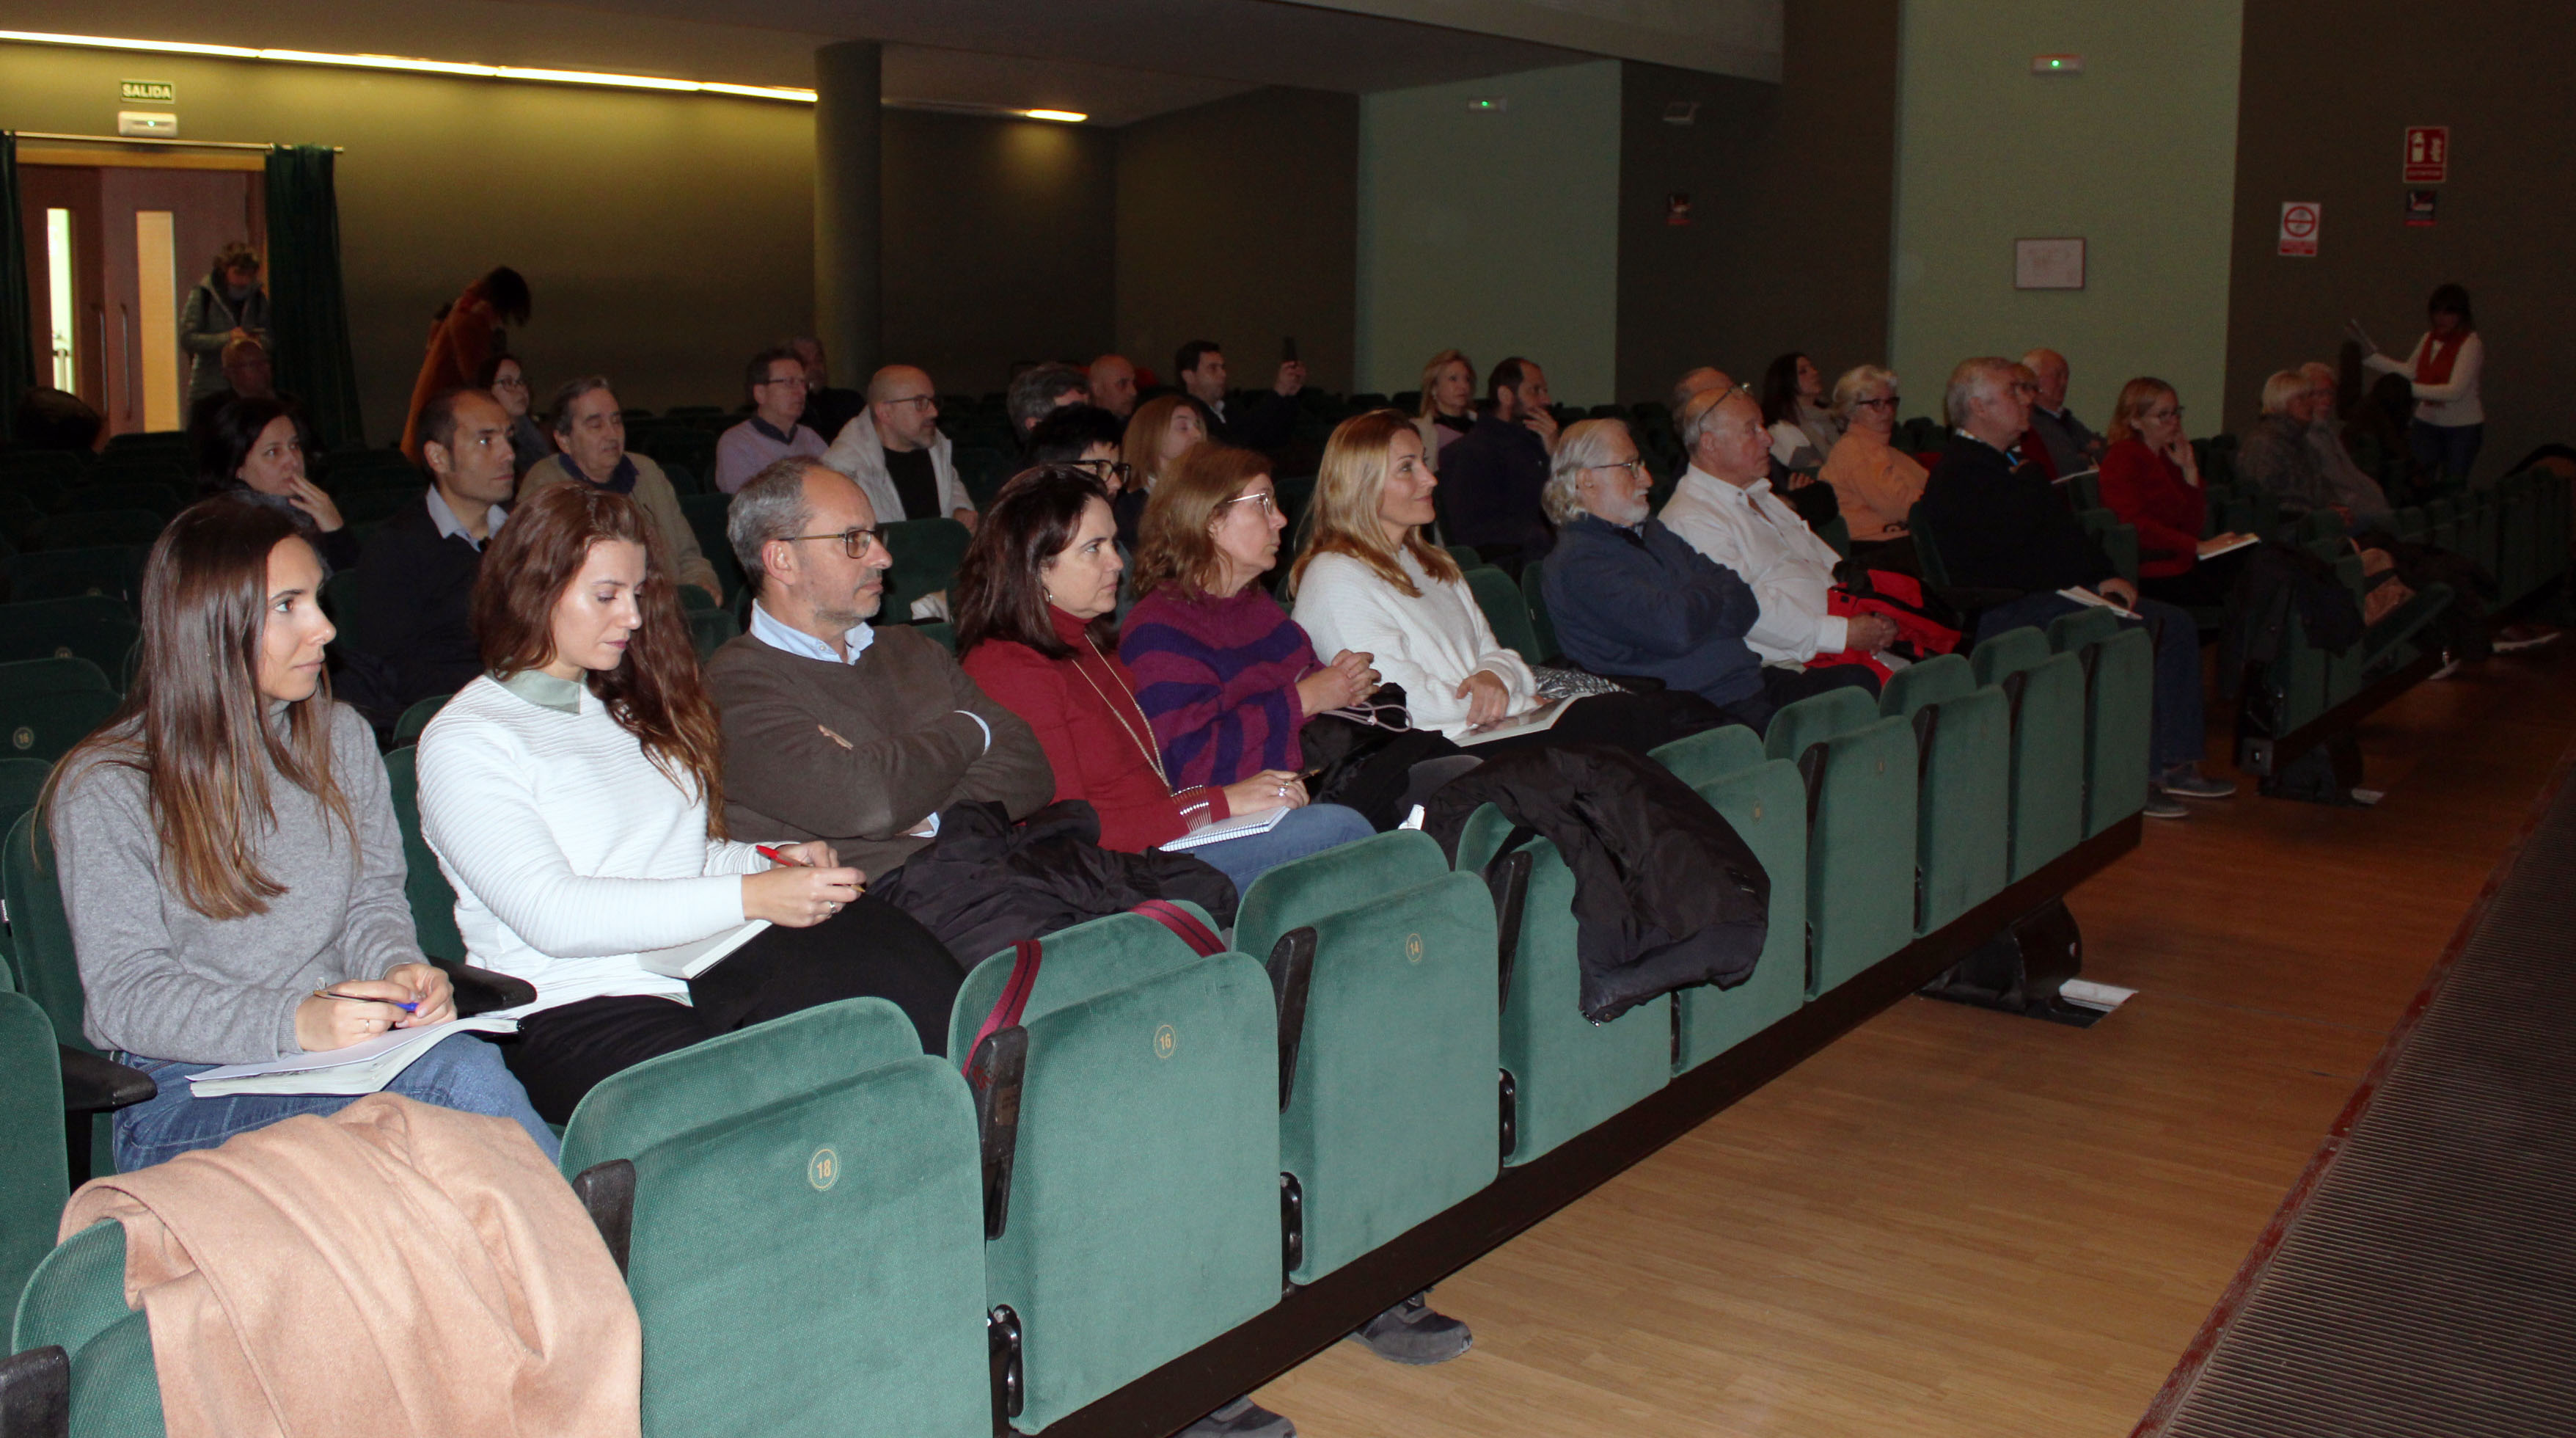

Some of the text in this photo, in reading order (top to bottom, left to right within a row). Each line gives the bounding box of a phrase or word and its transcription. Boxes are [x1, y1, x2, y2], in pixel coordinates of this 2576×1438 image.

[122, 84, 171, 99] SALIDA
[1160, 1033, 1172, 1050] 16
[817, 1159, 831, 1179] 18
